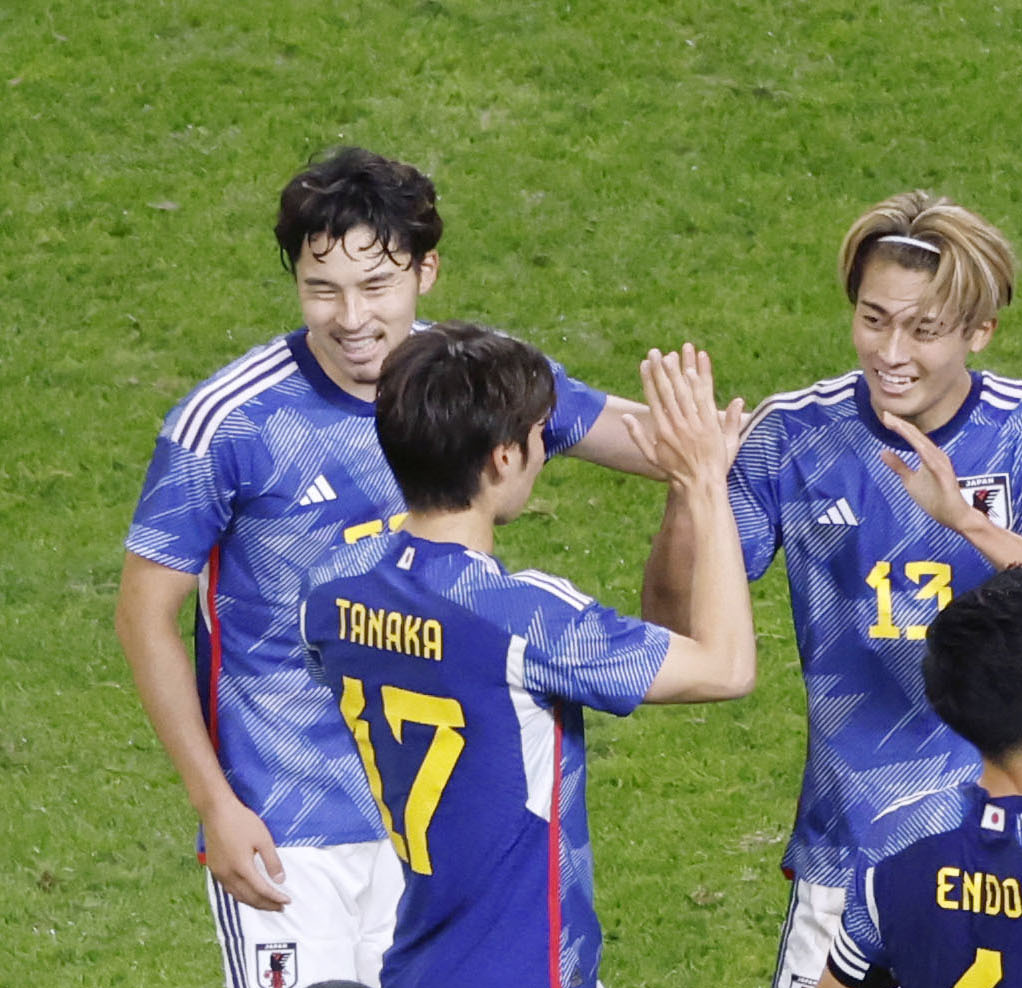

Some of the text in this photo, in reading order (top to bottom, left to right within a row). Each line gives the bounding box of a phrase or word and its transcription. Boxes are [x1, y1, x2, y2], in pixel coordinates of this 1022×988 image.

[966, 477, 994, 487] JAPAN
[336, 597, 443, 661] TANAKA
[340, 675, 465, 875] 17
